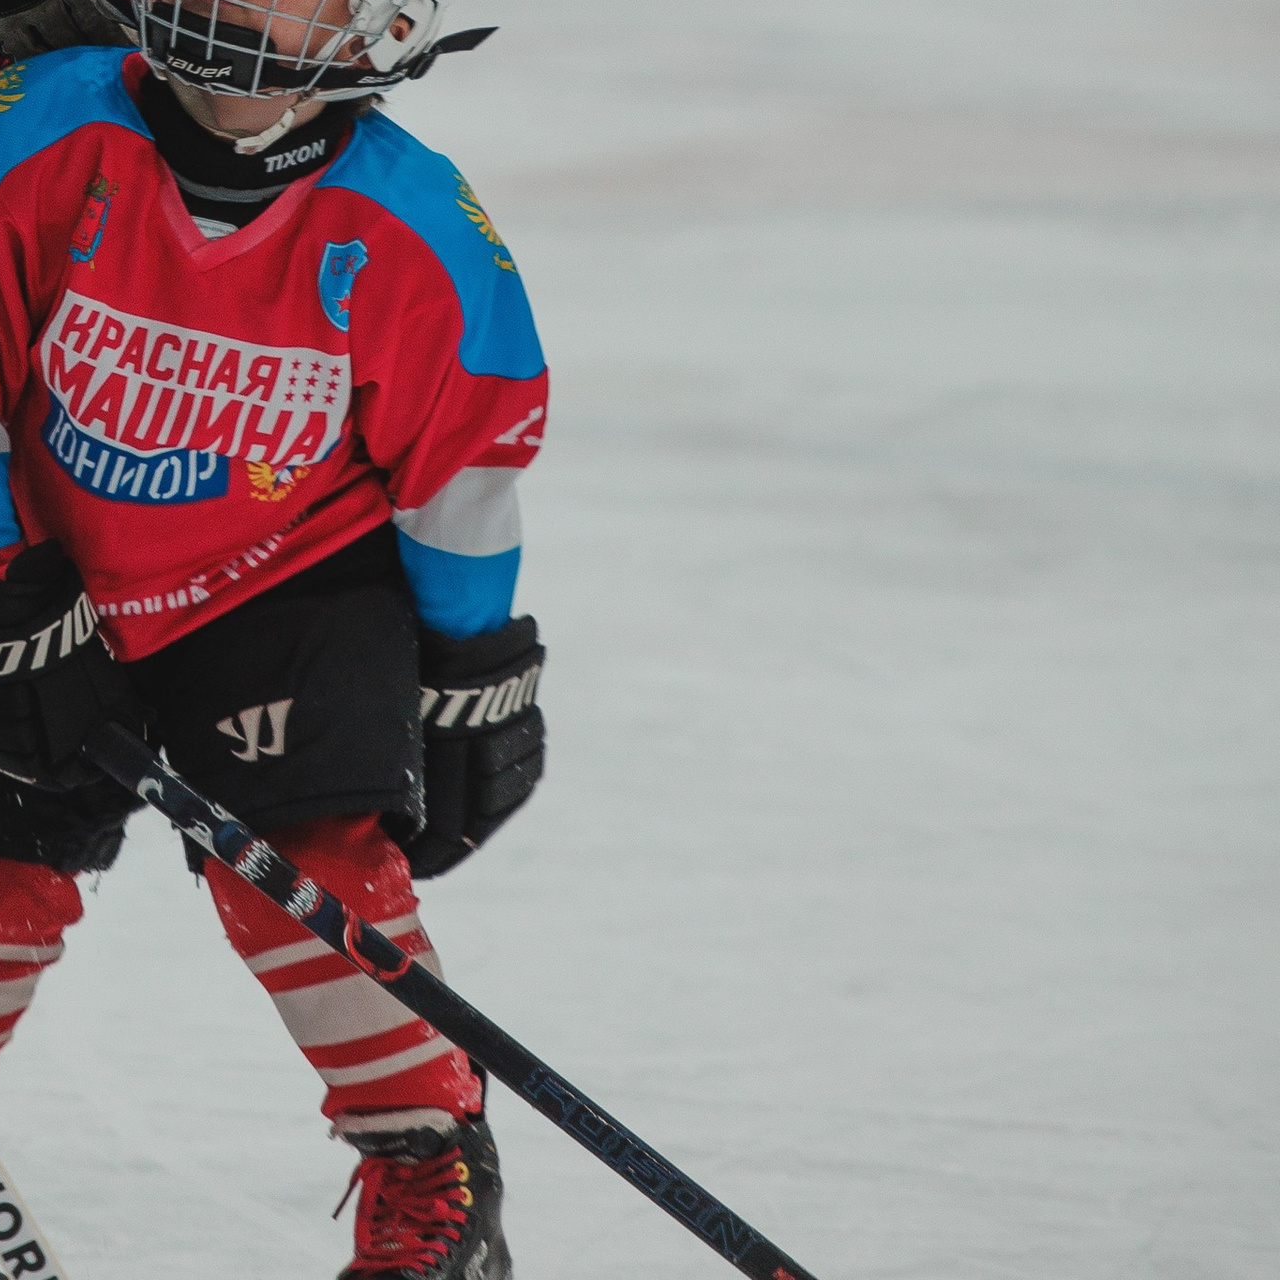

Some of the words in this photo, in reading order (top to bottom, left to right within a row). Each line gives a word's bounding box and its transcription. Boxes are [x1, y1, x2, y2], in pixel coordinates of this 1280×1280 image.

[264, 138, 326, 173] TIXON
[58, 302, 283, 403] КРАСНАЯ
[48, 341, 329, 466] МАШИНА
[47, 408, 218, 500] ЮНИОР
